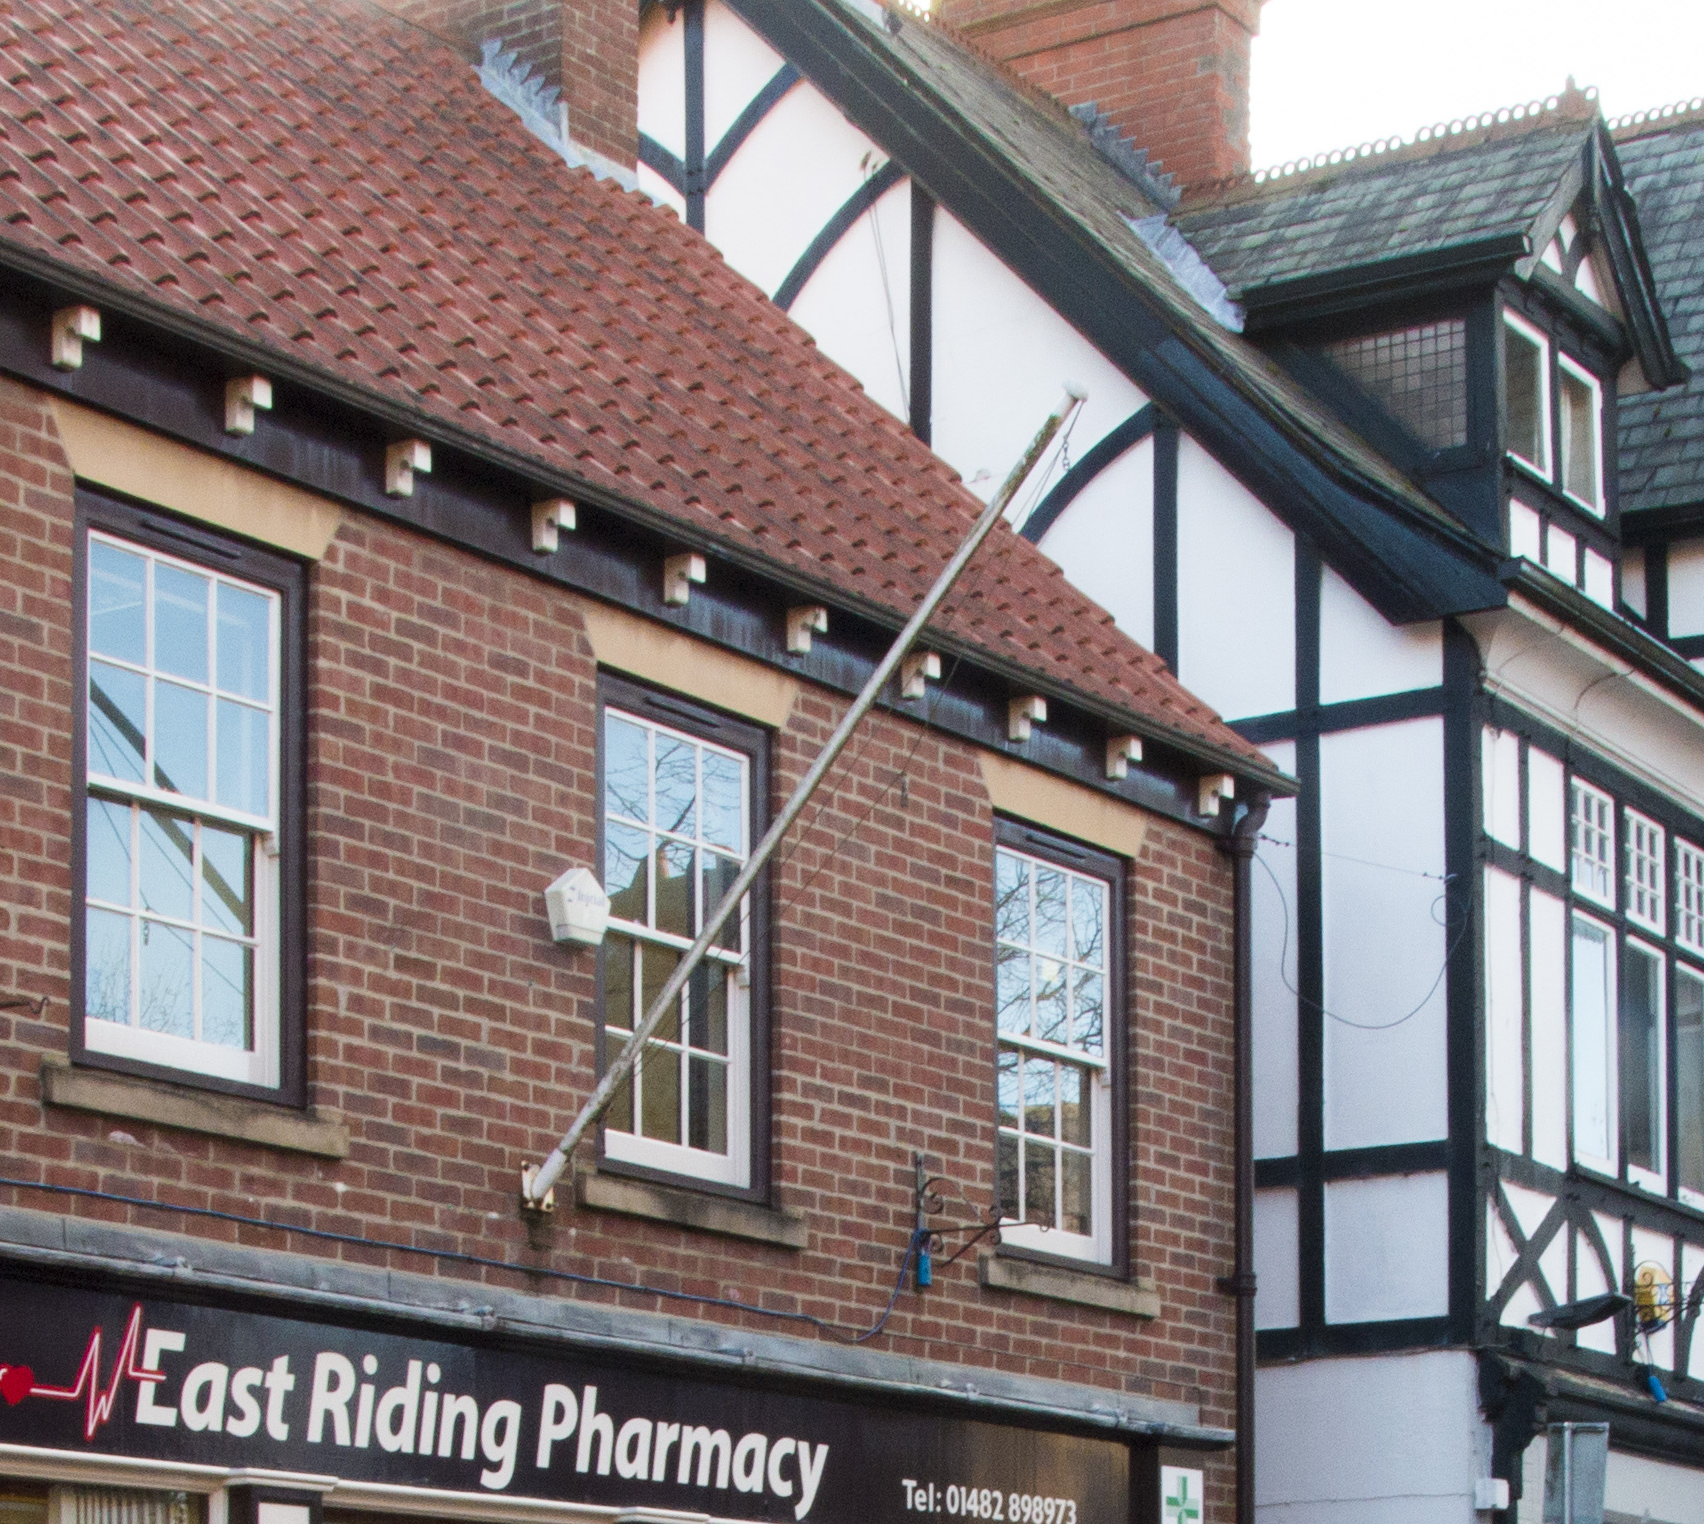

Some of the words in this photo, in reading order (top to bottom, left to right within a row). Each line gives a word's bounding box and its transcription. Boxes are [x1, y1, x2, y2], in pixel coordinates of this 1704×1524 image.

[135, 1329, 295, 1442] East
[306, 1351, 520, 1490] Riding
[536, 1384, 829, 1521] Pharmacy
[902, 1479, 942, 1514] Tel:
[946, 1484, 1004, 1521] 01482
